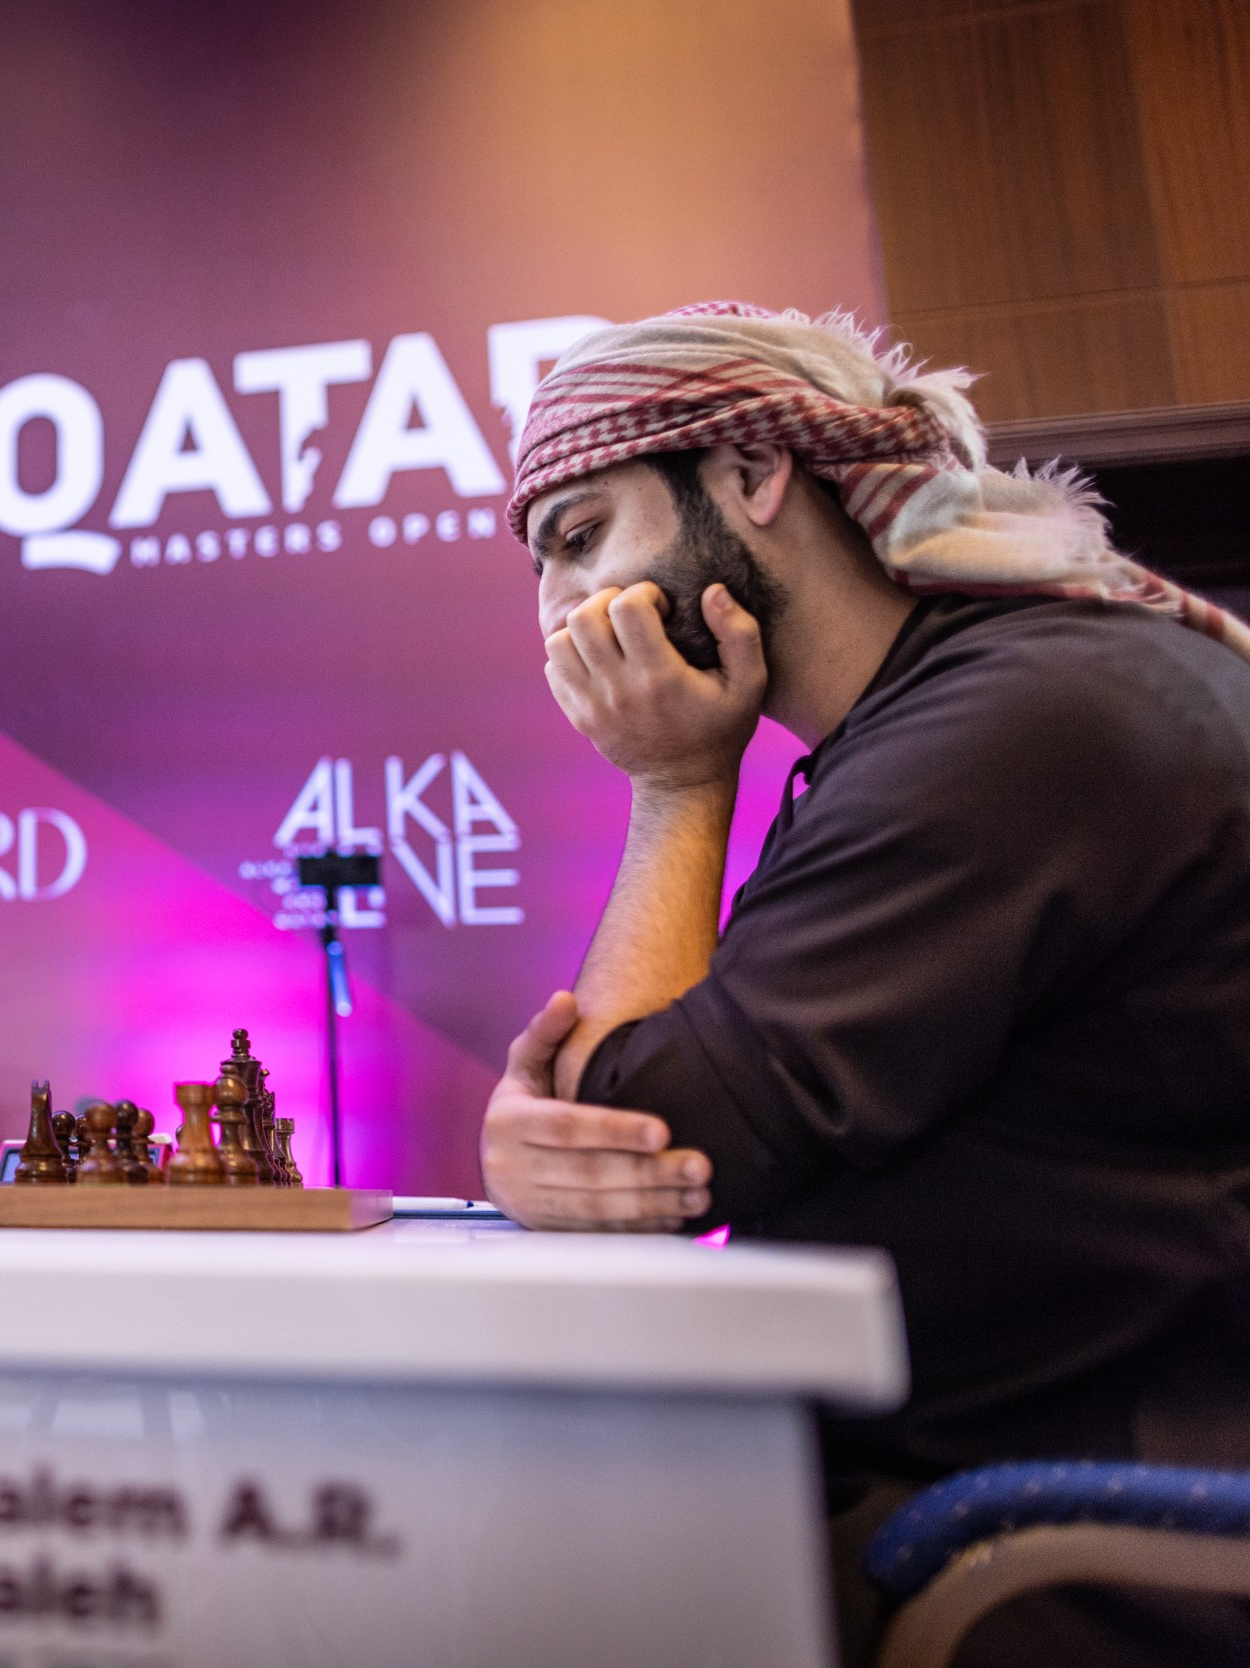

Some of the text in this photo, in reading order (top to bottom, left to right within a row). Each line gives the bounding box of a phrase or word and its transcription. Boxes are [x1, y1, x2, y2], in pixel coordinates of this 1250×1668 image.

[129, 506, 498, 568] MASTERS OPEN
[218, 1474, 402, 1563] A.R.
